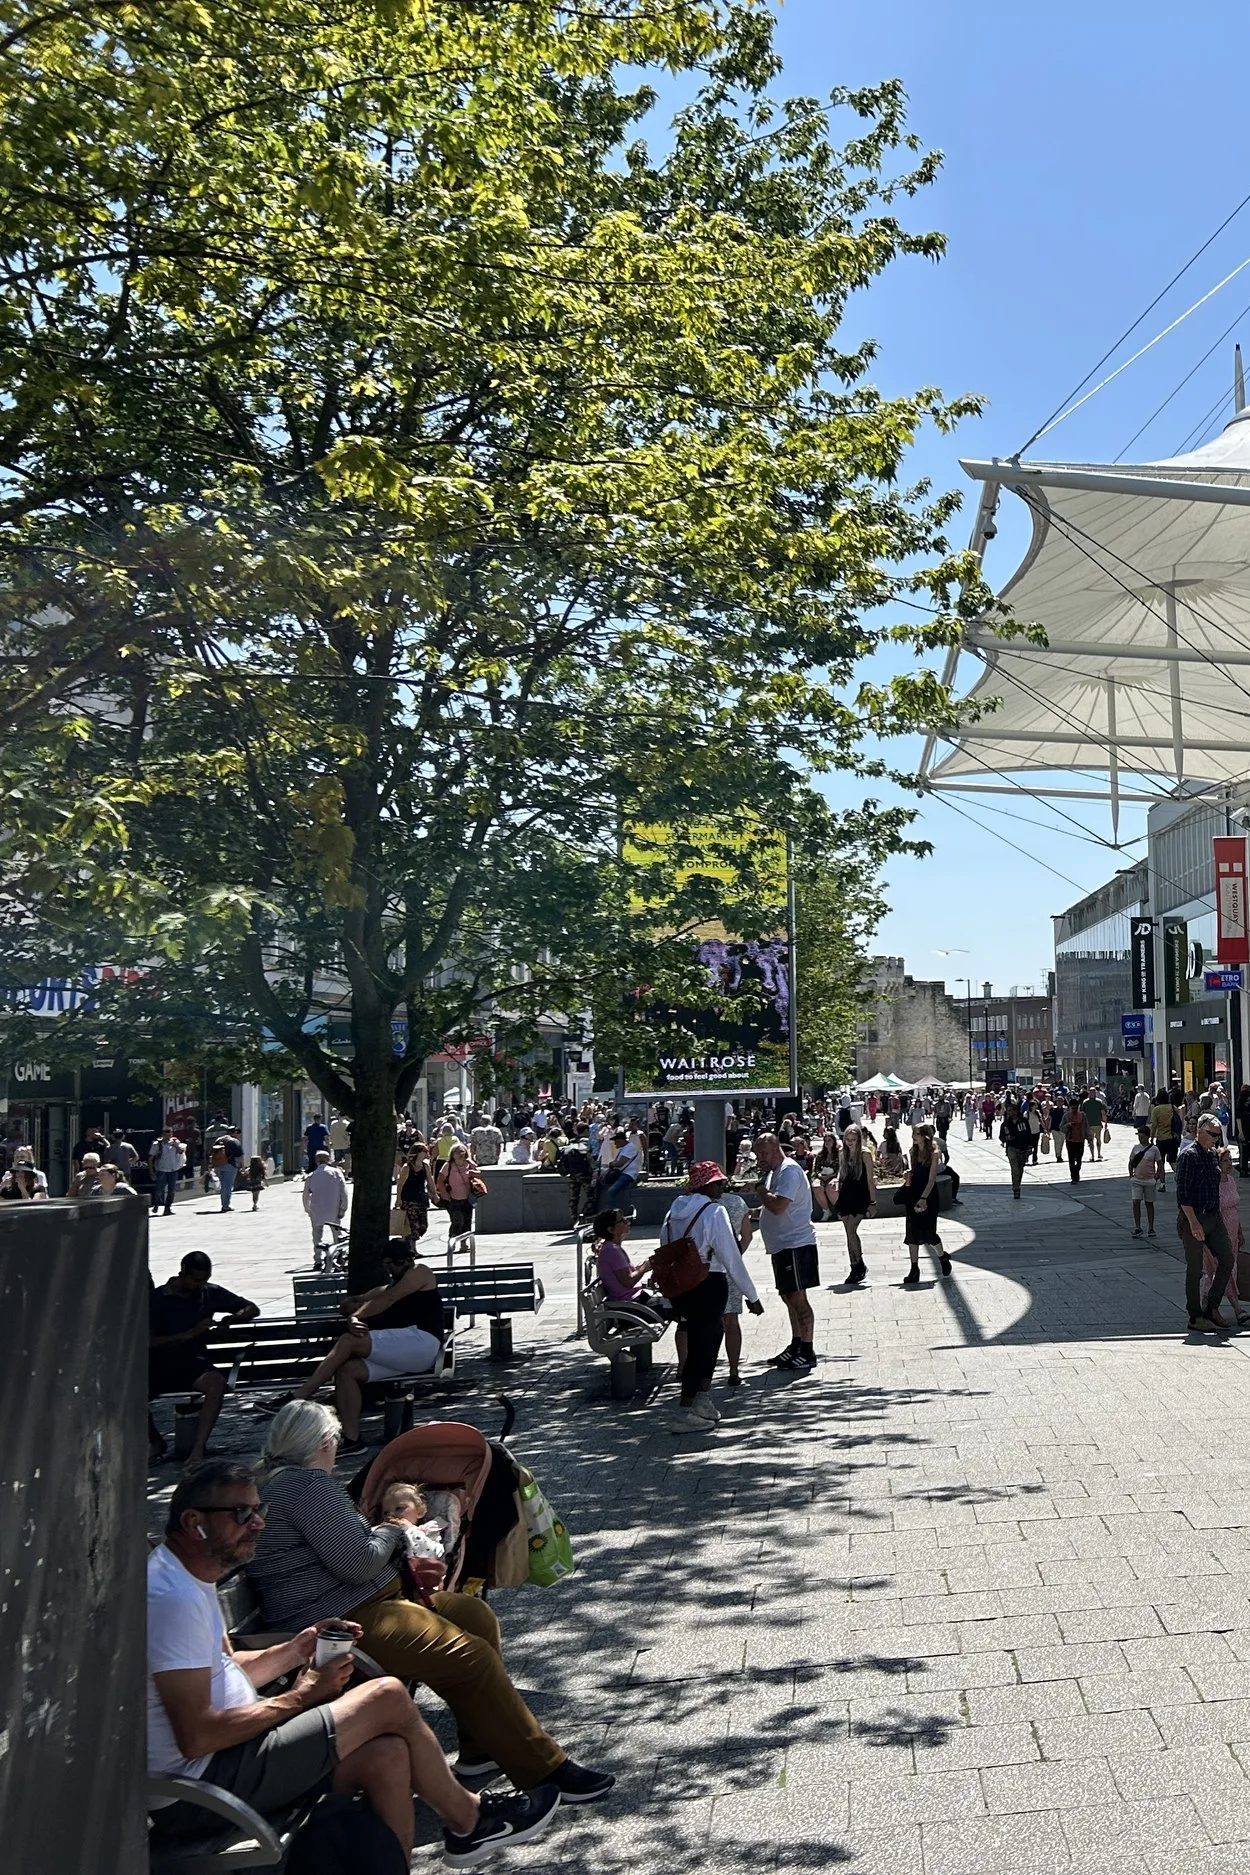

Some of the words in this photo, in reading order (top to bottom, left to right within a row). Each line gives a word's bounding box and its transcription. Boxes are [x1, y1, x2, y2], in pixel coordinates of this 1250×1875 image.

[1231, 883, 1239, 924] WESTQUAY
[1134, 922, 1152, 936] JD
[659, 1055, 756, 1069] WAITROSE
[15, 1061, 51, 1082] GAME
[666, 1073, 684, 1081] food
[708, 1073, 727, 1081] good
